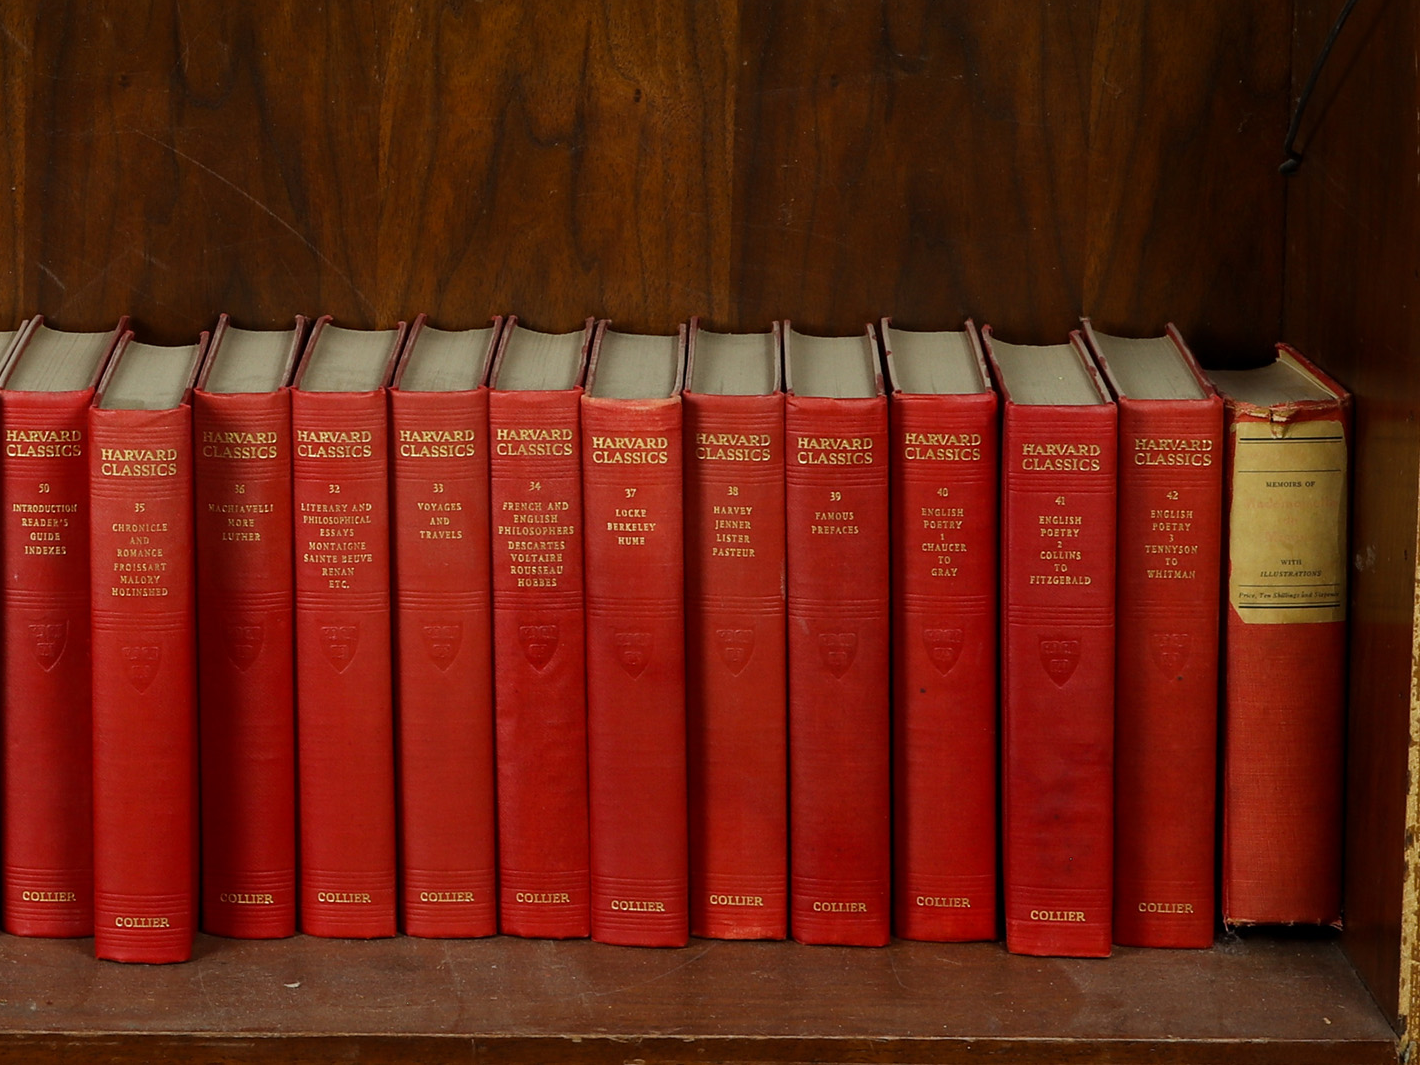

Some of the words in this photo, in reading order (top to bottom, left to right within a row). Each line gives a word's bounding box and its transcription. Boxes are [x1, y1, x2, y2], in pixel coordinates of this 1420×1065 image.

[797, 437, 873, 450] HARVARD
[1135, 439, 1212, 451] HARVARD
[101, 448, 177, 461] HARVARD
[797, 452, 873, 465] CLASSICS
[1135, 453, 1212, 466] CLASSICS
[101, 463, 176, 476] CLASSICS
[830, 492, 841, 501] 39
[1166, 491, 1178, 500] 42
[135, 503, 145, 512] 35
[815, 512, 854, 520] FAMOUS
[1151, 510, 1193, 519] ENGLISH
[112, 523, 167, 532] CHRONICLE
[811, 526, 859, 534] PREFACES
[1152, 523, 1191, 531] POETRY
[117, 549, 163, 557] ROMANCE
[1145, 545, 1198, 554] TENNYSON
[1165, 558, 1178, 566] TO
[114, 563, 167, 571] FROISSART
[1147, 570, 1195, 578] WHITMAN
[120, 576, 160, 584] MALORY
[112, 588, 168, 596] HOLINSHED
[813, 901, 866, 912] COLLIER
[115, 917, 169, 927] COLLIER
